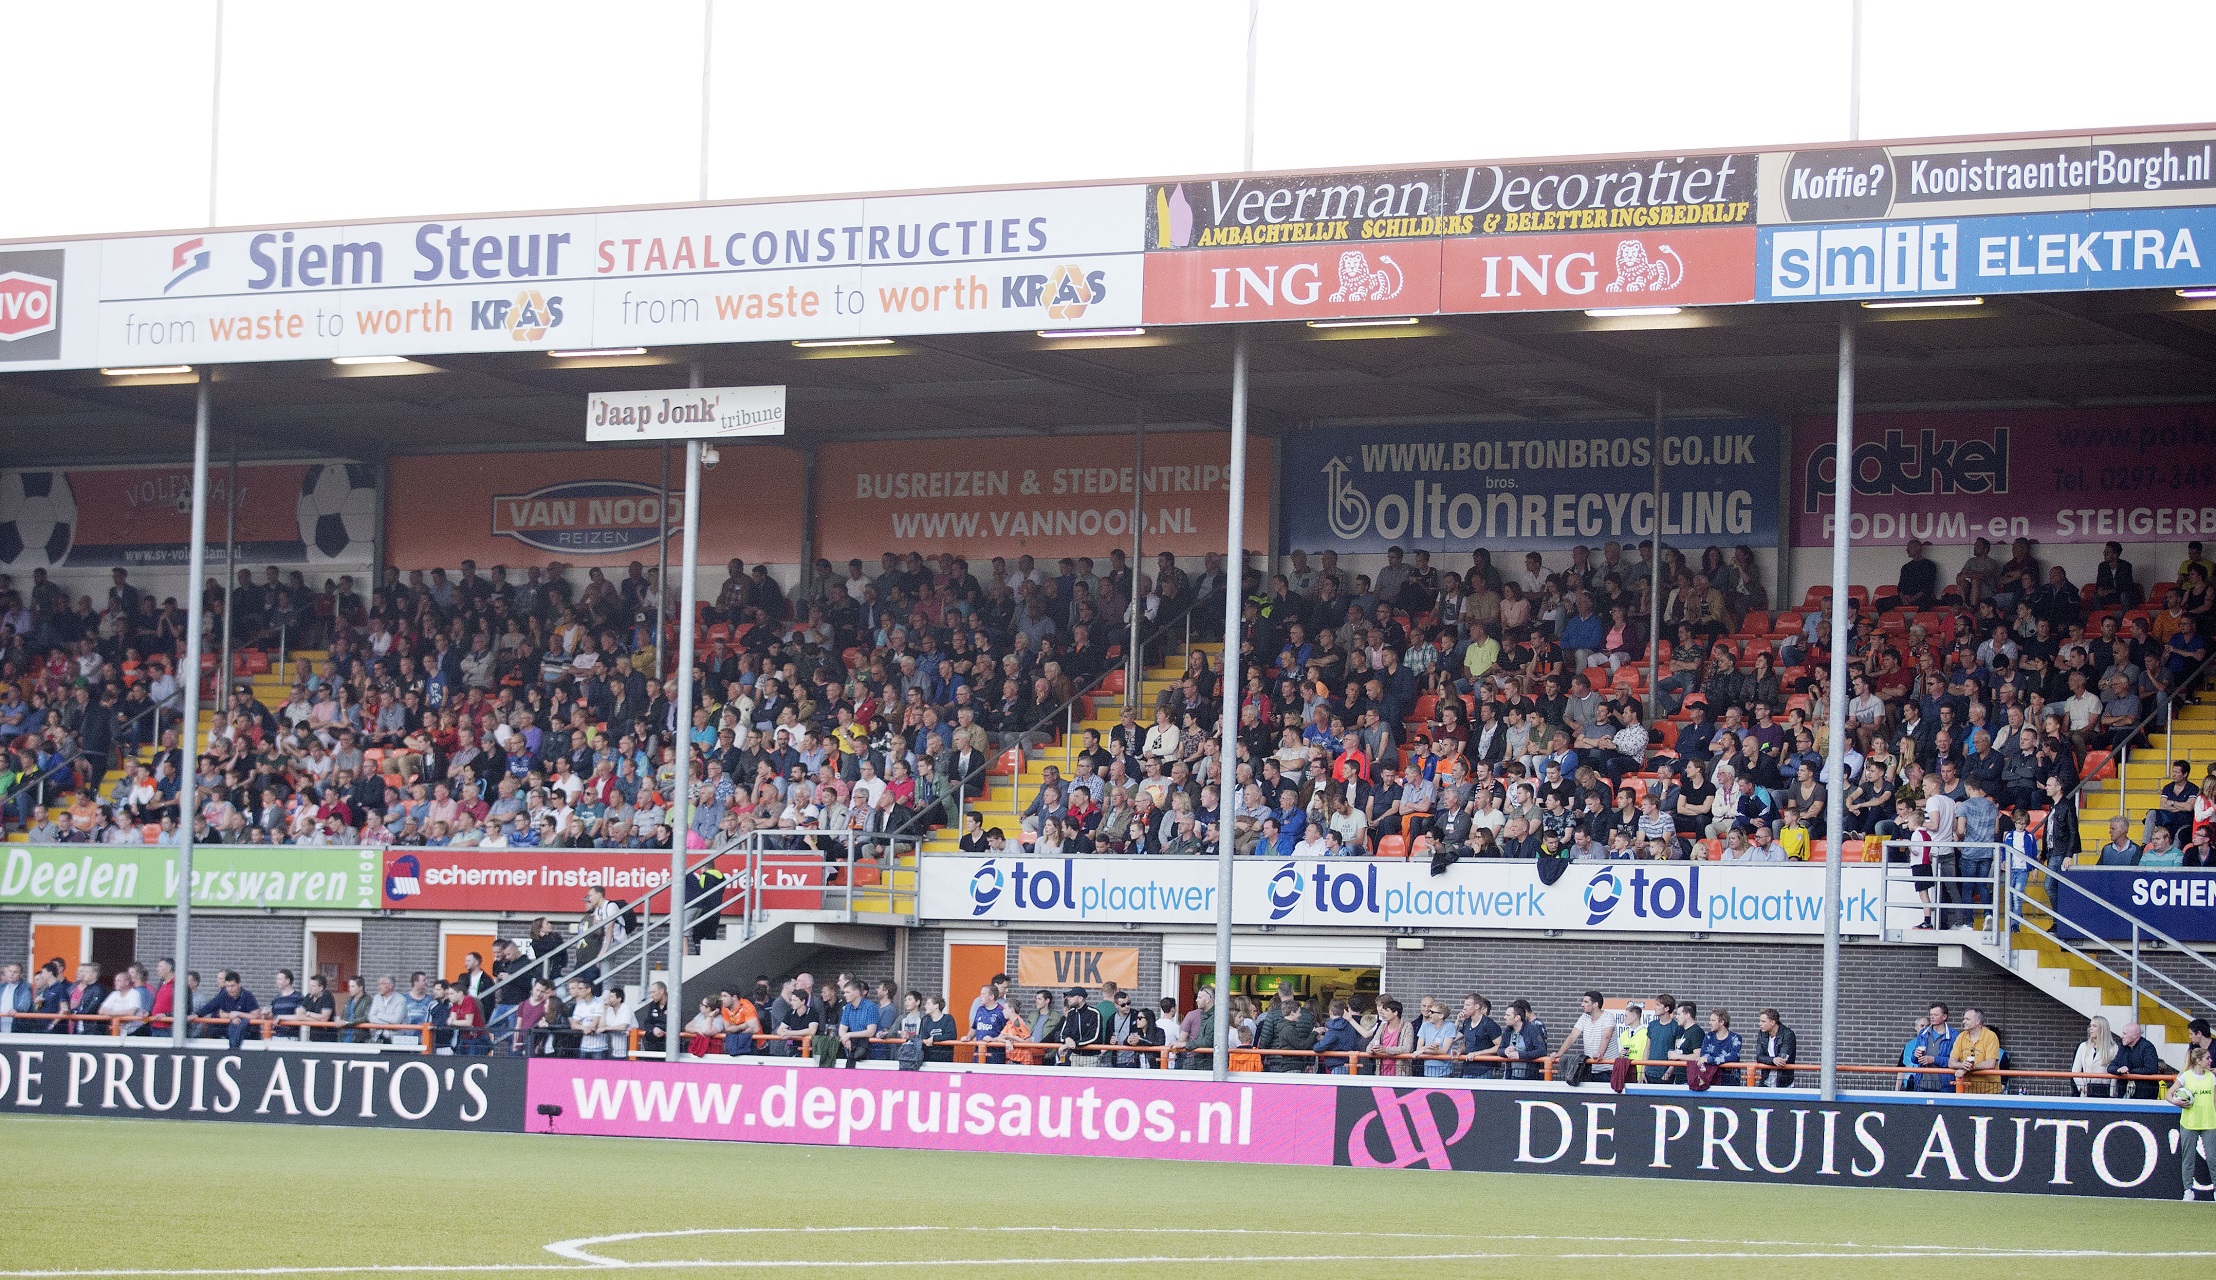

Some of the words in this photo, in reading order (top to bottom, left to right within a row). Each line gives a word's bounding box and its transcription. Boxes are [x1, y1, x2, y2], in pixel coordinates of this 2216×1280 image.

[1210, 176, 1429, 222] Veerman
[1458, 154, 1737, 215] Decoratief
[1791, 164, 1884, 200] Koffie?
[1911, 143, 2210, 194] KooistraenterBorgh.nl
[1198, 220, 1349, 246] AMBACHTELIJK
[1362, 213, 1474, 238] SCHILDERS
[1483, 214, 1497, 232] &
[1505, 203, 1751, 231] BELETTERINGSBEDRIJF
[248, 232, 383, 290] Siem
[414, 224, 571, 281] Steur
[597, 217, 1048, 273] STAALCONSTRUCTIES
[1482, 251, 1599, 297] ING
[1772, 225, 1957, 296] smit
[1978, 228, 2202, 277] ELEKTRA
[621, 291, 700, 325] from
[715, 285, 819, 320] waste
[834, 283, 865, 315] to
[879, 275, 988, 310] worth
[1002, 270, 1107, 309] KRAS
[1211, 263, 1323, 309] ING
[126, 313, 195, 346] from
[209, 309, 303, 342] waste
[316, 307, 344, 337] to
[357, 300, 453, 334] worth
[471, 296, 564, 331] KRAS
[591, 396, 652, 433] 'Jaap
[658, 395, 720, 425] Jonk'
[721, 405, 783, 429] tribune
[857, 470, 1009, 498] BUSREIZEN
[1019, 469, 1041, 496] &
[1485, 476, 1519, 489] bros.
[1804, 427, 2010, 514] patkel
[509, 501, 576, 527] VAN
[560, 531, 628, 544] REIZEN
[891, 508, 1197, 538] WWW.VANNOOD.NL
[2055, 507, 2216, 537] STEIGERB
[1, 849, 139, 898] Deelen
[164, 859, 348, 901] Verswaren
[425, 866, 537, 887] schermer
[541, 864, 769, 890] installatietniek
[777, 870, 808, 887] bv
[1011, 859, 1076, 910] tol
[1081, 880, 1215, 918] plaatwer
[1312, 863, 1380, 913] tol
[1385, 882, 1546, 922] plaatwerk
[1630, 866, 1702, 919] tol
[1709, 887, 1879, 928] plaatwrk
[1054, 951, 1103, 983] VIK
[0, 1050, 44, 1107] E
[65, 1052, 242, 1113] PRUIS
[255, 1056, 489, 1122] AUTO'S
[572, 1068, 1252, 1146] www.depruisautos.nl
[1513, 1099, 1616, 1166] DE
[1648, 1104, 1886, 1177] PRUIS
